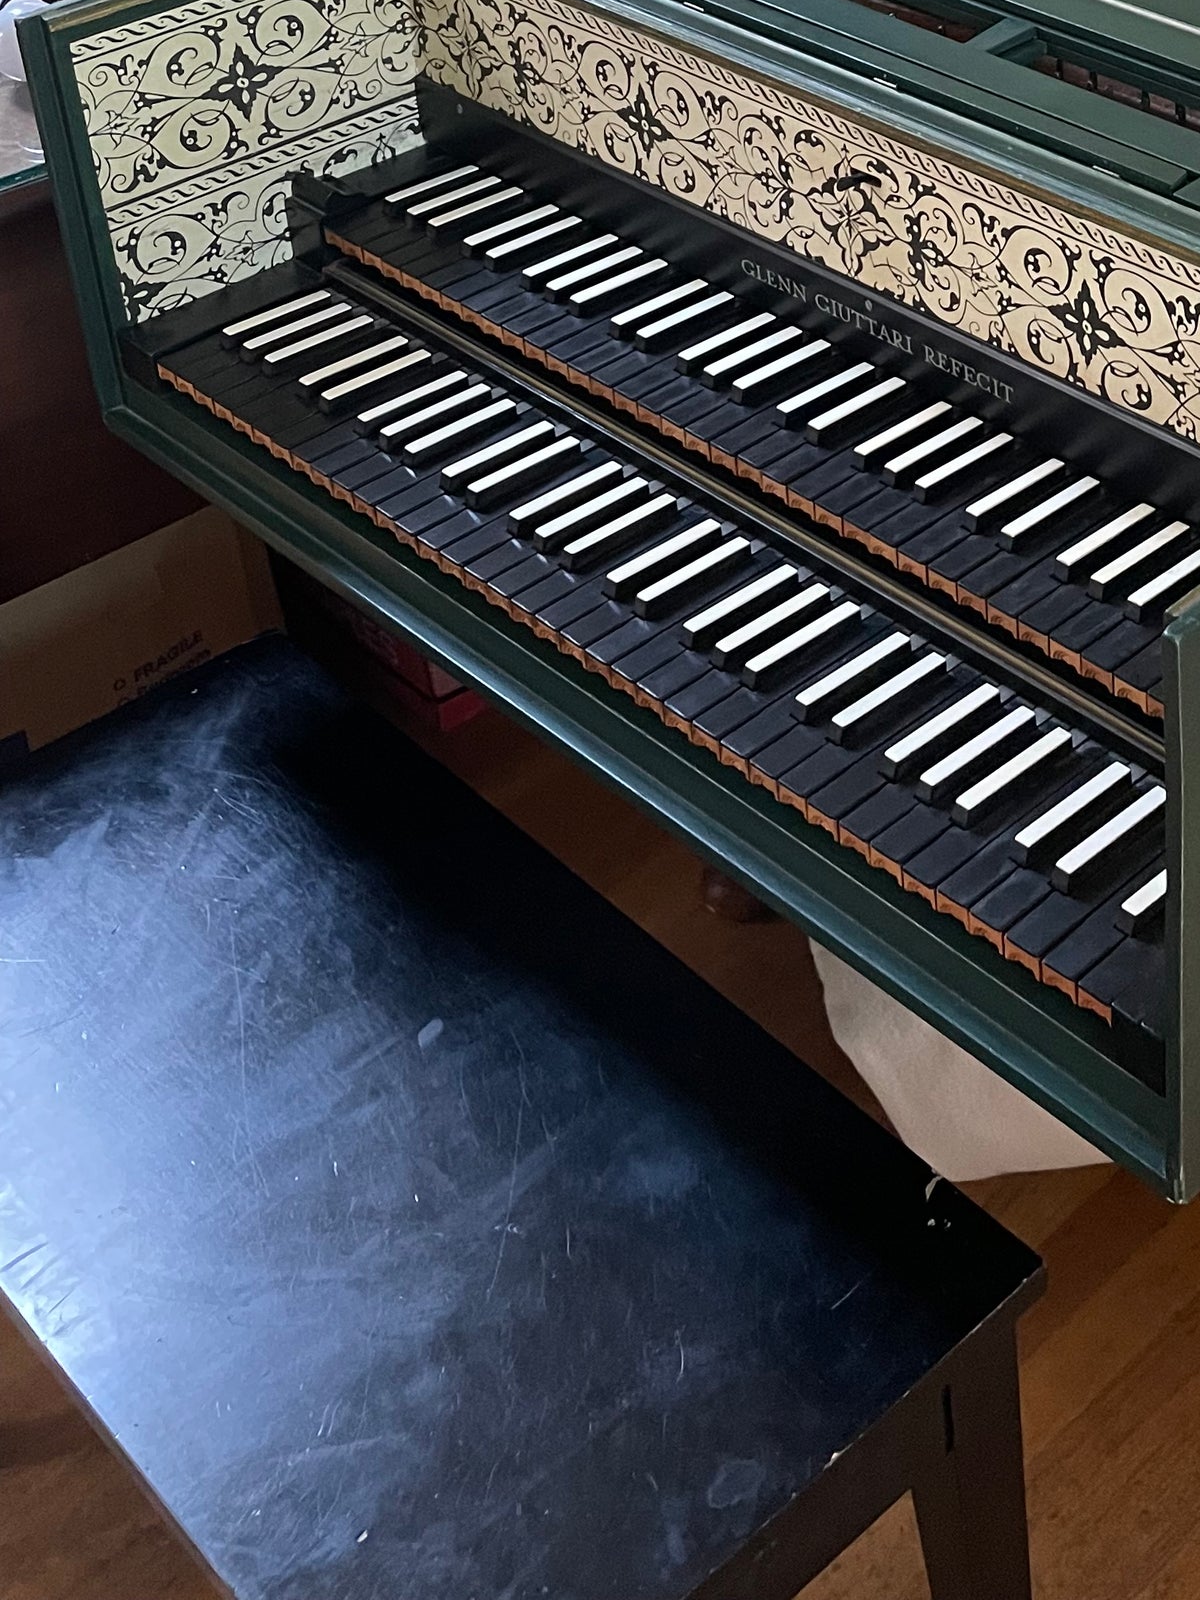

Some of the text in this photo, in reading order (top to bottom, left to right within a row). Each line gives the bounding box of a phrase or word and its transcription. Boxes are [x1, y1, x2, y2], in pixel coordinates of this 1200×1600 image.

[741, 259, 1014, 404] GLENN GIUTTARI REFECIT
[133, 629, 204, 682] FRAGILE
